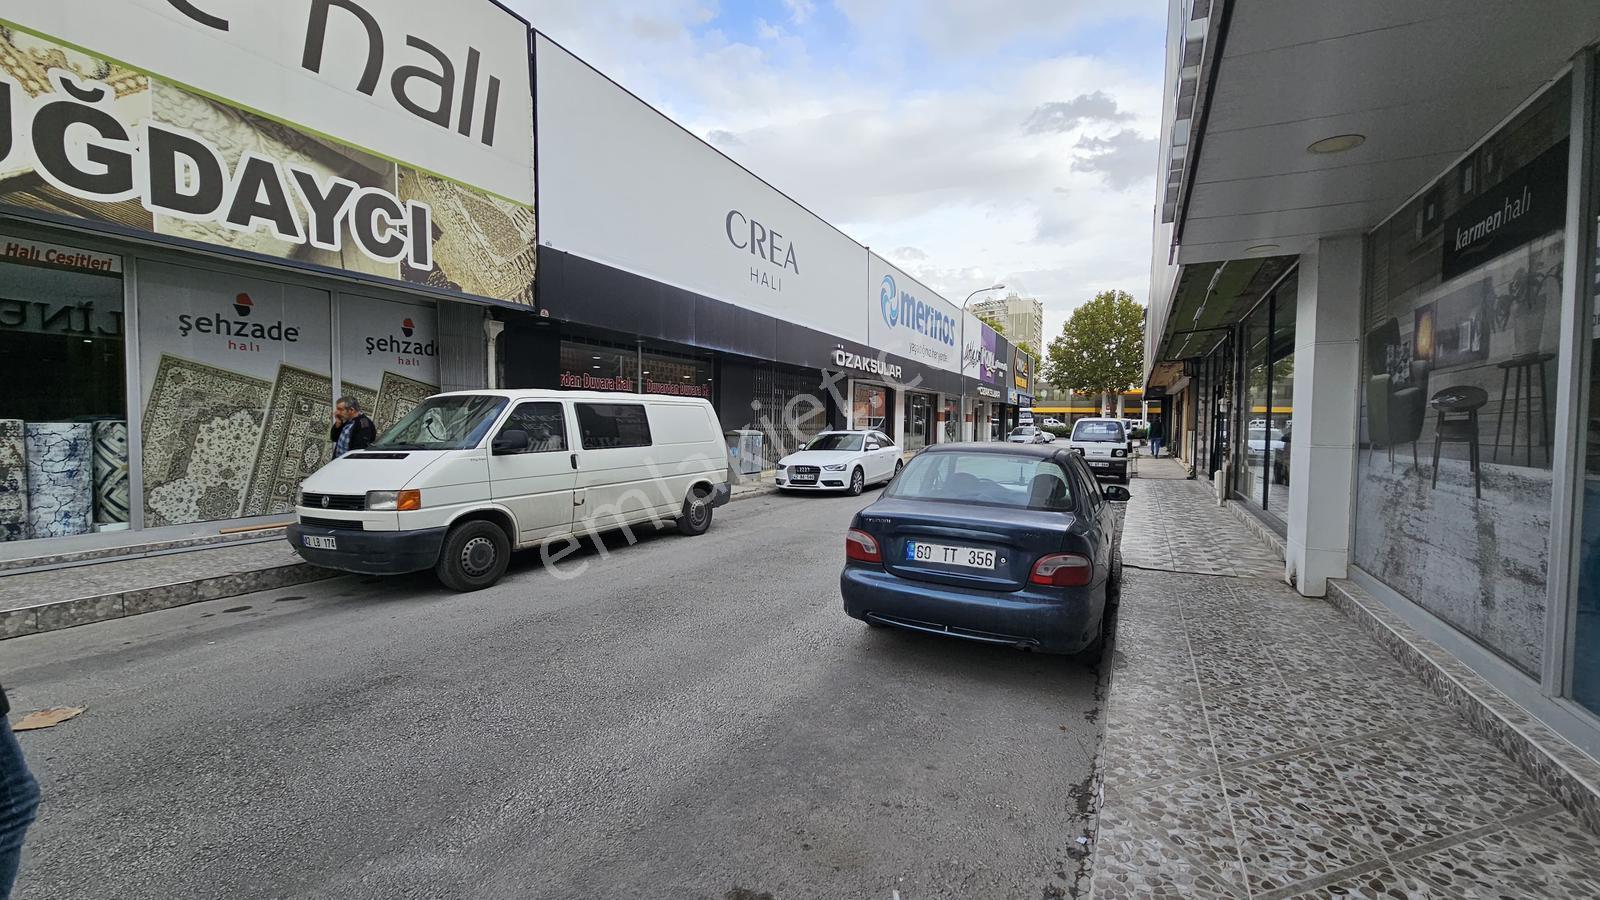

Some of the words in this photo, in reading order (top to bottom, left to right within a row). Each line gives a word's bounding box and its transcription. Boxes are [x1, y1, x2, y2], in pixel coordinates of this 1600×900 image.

[1455, 211, 1501, 251] karmen
[1503, 185, 1531, 224] halı
[5, 242, 42, 260] Halı
[725, 209, 799, 275] CREA
[750, 266, 781, 292] HALI
[178, 313, 299, 343] şehzade
[900, 290, 956, 347] merinos
[228, 340, 260, 353] halı
[365, 334, 440, 357] şehzad
[398, 356, 420, 367] halı
[835, 343, 903, 379] ÖZAKSULAR
[324, 538, 335, 548] 174
[916, 545, 932, 560] 60
[943, 547, 958, 562] TT
[968, 550, 993, 567] 356
